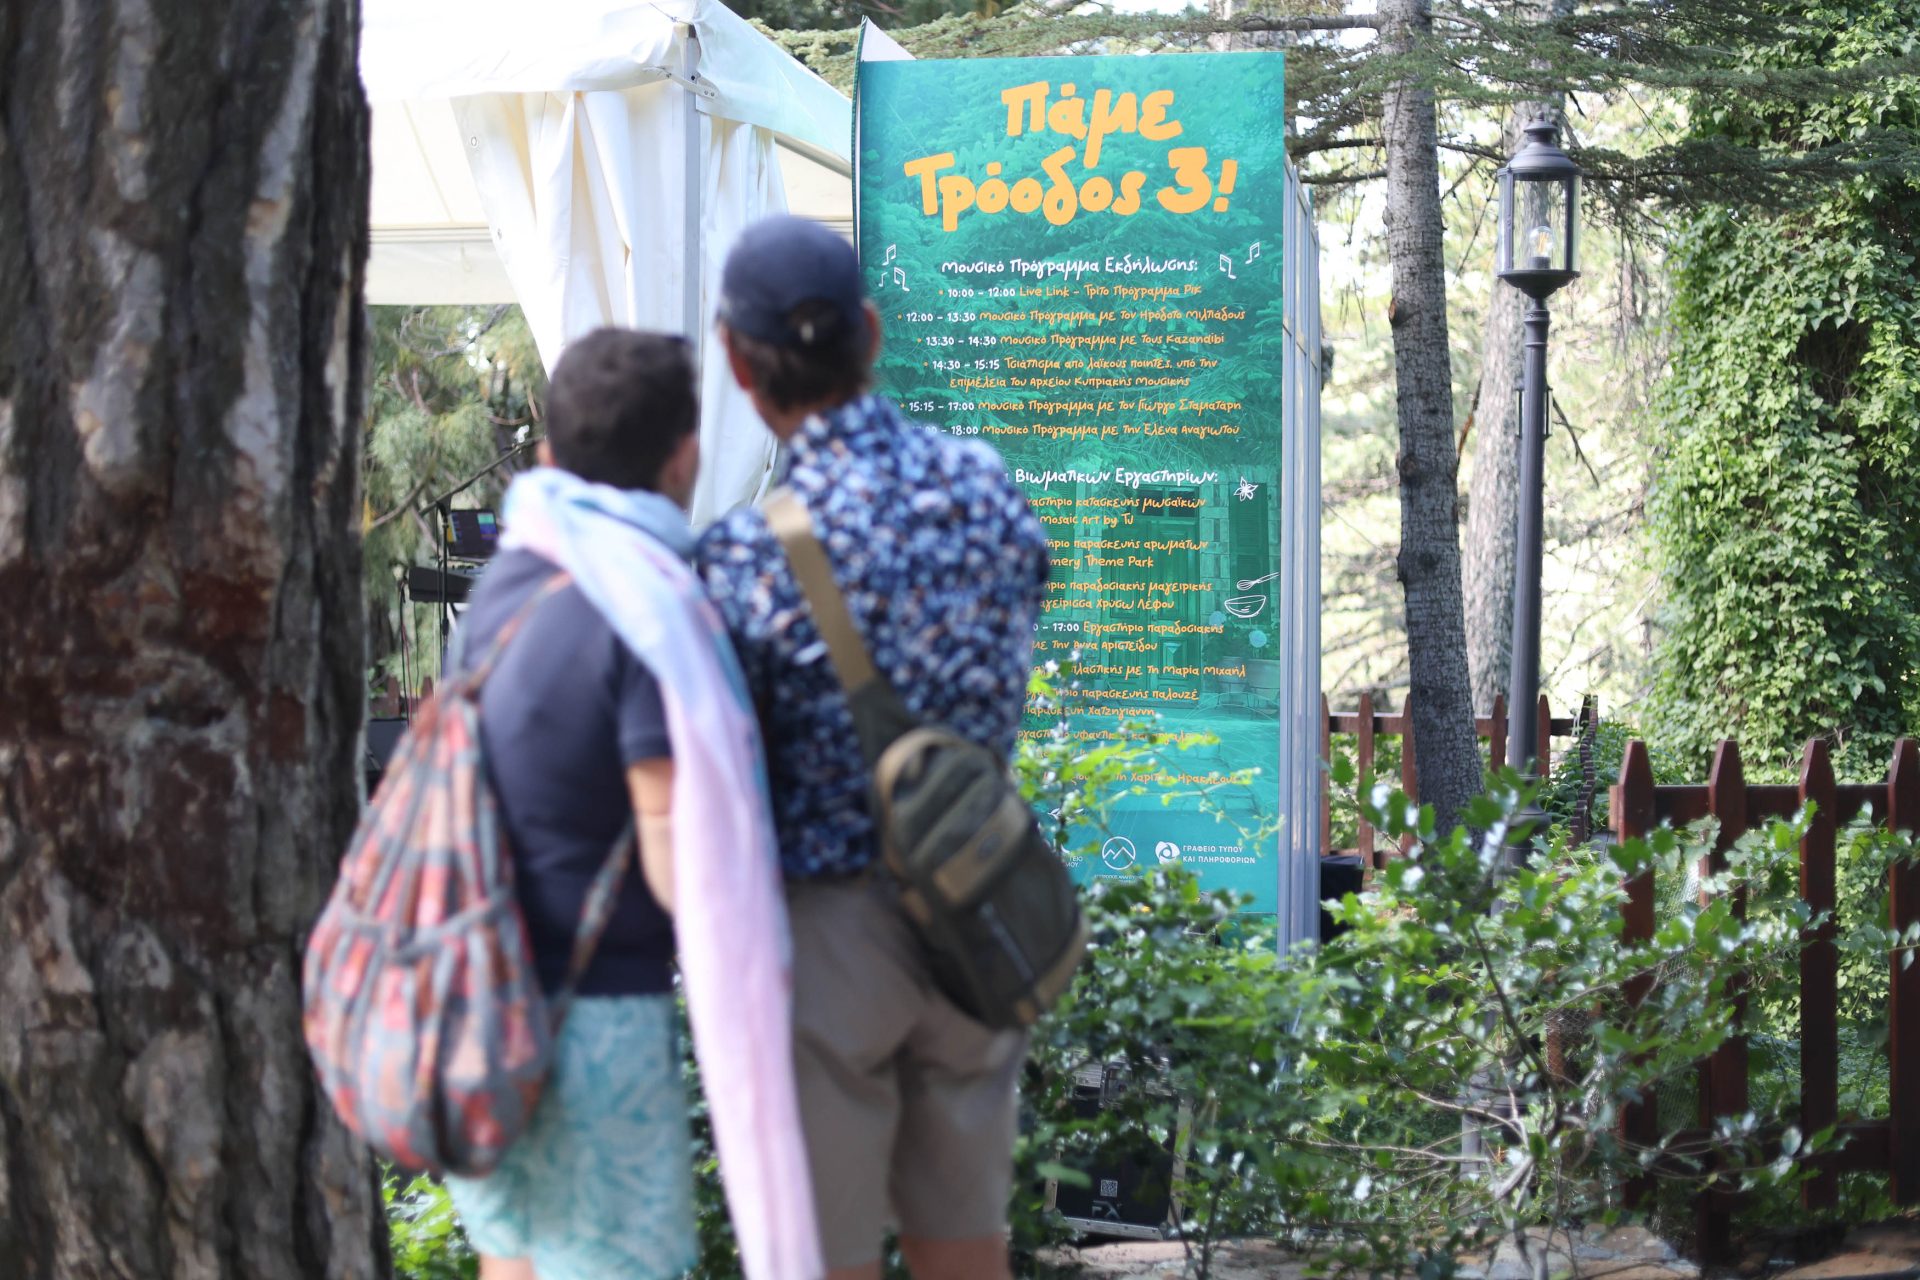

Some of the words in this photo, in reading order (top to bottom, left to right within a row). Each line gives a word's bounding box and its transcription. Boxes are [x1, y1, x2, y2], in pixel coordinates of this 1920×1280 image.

[1001, 81, 1183, 169] Πάμε
[904, 145, 1147, 232] Τρόοδος
[1157, 147, 1238, 214] 3!
[941, 260, 1005, 274] Μουσικό
[1010, 259, 1099, 281] Πρόγραμμα
[1105, 254, 1198, 274] Εκδήλωσης:
[948, 288, 975, 298] 10:00
[988, 287, 1016, 298] 12:00
[1019, 285, 1042, 297] Live
[1046, 285, 1070, 297] Link
[1084, 284, 1110, 299] Τρίτο
[1114, 284, 1180, 302] Πρόγραμμα
[906, 311, 934, 322] 12:00
[948, 311, 976, 322] 13:30
[979, 311, 1027, 322] Μουσικό
[1030, 310, 1096, 327] Πρόγραμμα
[1098, 311, 1116, 327] με
[1120, 310, 1137, 320] τον
[1140, 306, 1183, 323] Ηρόδοτο
[926, 335, 955, 347] 13:30
[968, 335, 997, 347] 14:30
[999, 335, 1047, 346] Μουσικό
[1051, 333, 1117, 351] Πρόγραμμα
[1119, 335, 1138, 351] με
[1141, 334, 1163, 344] τους
[932, 360, 961, 371] 14:30
[974, 358, 1000, 370] 15:15
[1064, 359, 1084, 369] από
[1085, 356, 1127, 371] λαϊκούς
[1176, 359, 1196, 369] υπό
[1199, 358, 1218, 368] την
[950, 375, 1007, 393] επιμέλεια
[1030, 376, 1072, 390] Αρχείου
[1074, 376, 1132, 389] Κυπριακής
[1135, 376, 1190, 387] Μουσικής
[909, 401, 934, 412] 15:15
[948, 401, 975, 411] 17:00
[978, 401, 1025, 412] Μουσικό
[1028, 399, 1095, 417] Πρόγραμμα
[1096, 401, 1115, 417] με
[1118, 400, 1135, 410] τον
[951, 424, 979, 436] 18:00
[982, 425, 1029, 436] Μουσικό
[1032, 423, 1098, 440] Πρόγραμμα
[1100, 425, 1119, 441] με
[1122, 424, 1141, 435] την
[1115, 467, 1219, 490] Εργαστηρίων:
[1026, 496, 1073, 510] γαστήριο
[1076, 496, 1140, 508] κατασκευής
[1040, 513, 1079, 525] Mosaic
[1103, 515, 1118, 528] by
[1074, 538, 1140, 551] παρασκευής
[1143, 539, 1209, 555] αρωμάτων
[1085, 553, 1125, 567] Theme
[1128, 555, 1154, 568] Park
[1070, 577, 1146, 593] παραδοσιακής
[1147, 581, 1213, 597] μαγειρικής
[1040, 597, 1093, 613] αγείρισσα
[1096, 598, 1135, 611] Χρύσω
[1052, 622, 1080, 632] 17:00
[1083, 620, 1144, 636] Εργαστήριο
[1147, 620, 1225, 636] παραδοσιακής
[1052, 639, 1070, 649] την
[1101, 637, 1158, 653] Αριστείδου
[1124, 665, 1143, 681] με
[1162, 664, 1200, 678] Μαρία
[1082, 688, 1149, 701] παρασκευής
[1182, 845, 1216, 853] ΓΡΑΦΕΙΟ
[1219, 845, 1244, 853] ΤΥΠΟΥ
[1182, 855, 1196, 863] ΚΑΙ
[1198, 856, 1256, 864] ΠΛΗΡΟΦΟΡΙΩΝ
